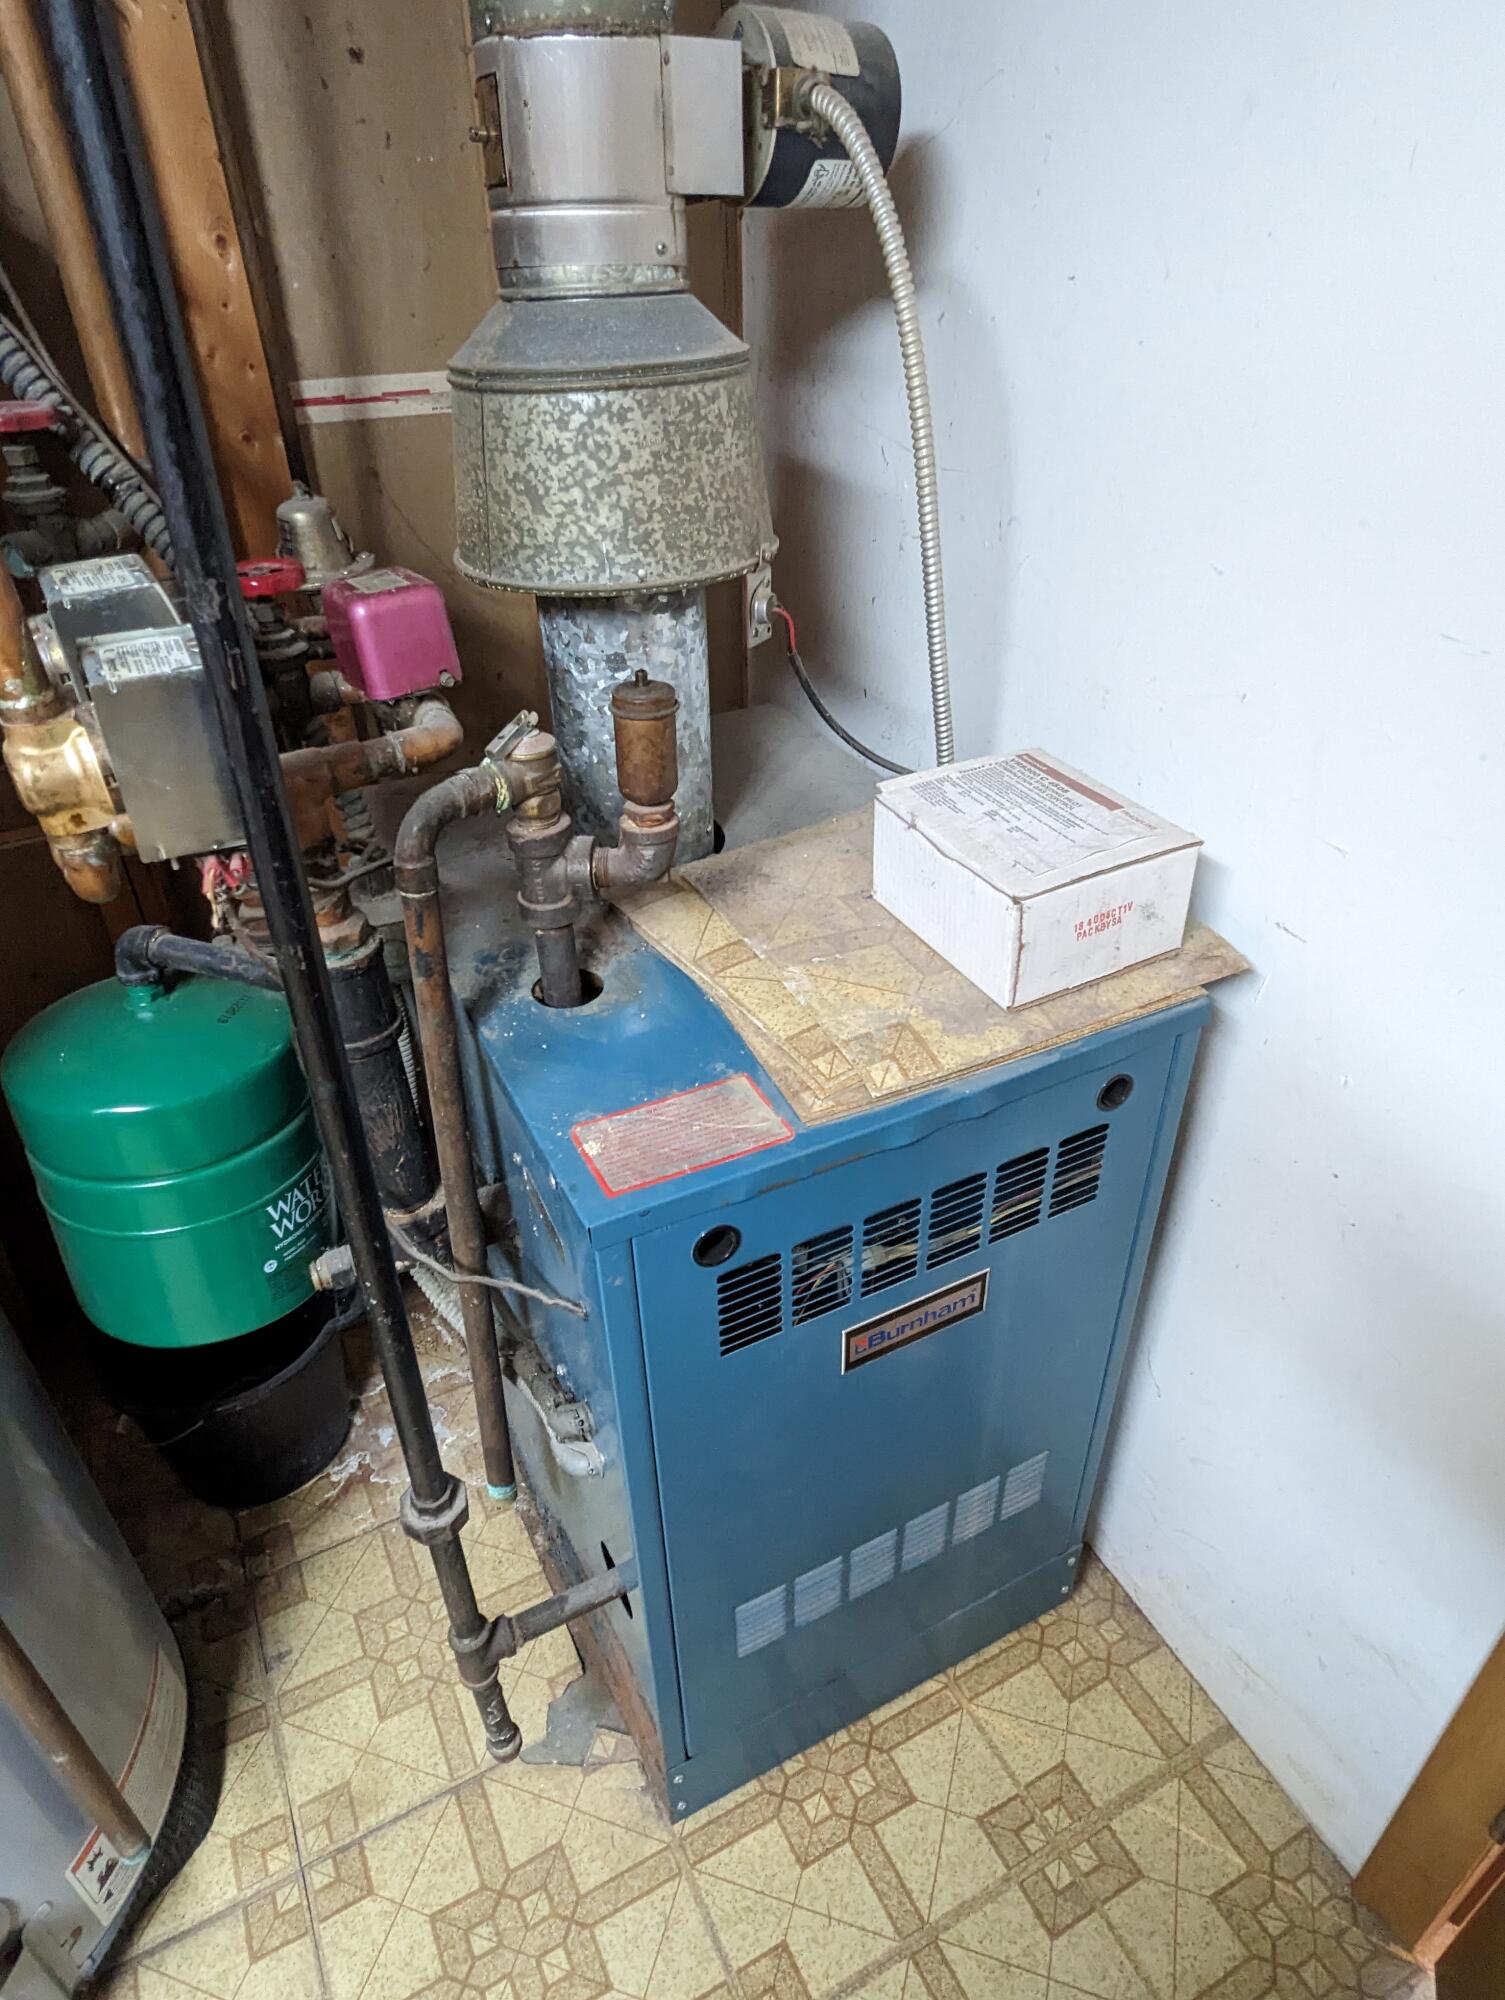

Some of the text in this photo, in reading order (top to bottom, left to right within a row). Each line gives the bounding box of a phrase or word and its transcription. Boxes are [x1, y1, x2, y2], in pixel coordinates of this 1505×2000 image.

[265, 1167, 321, 1221] WATE
[270, 1189, 323, 1239] WOR
[867, 1293, 976, 1349] Burnham
